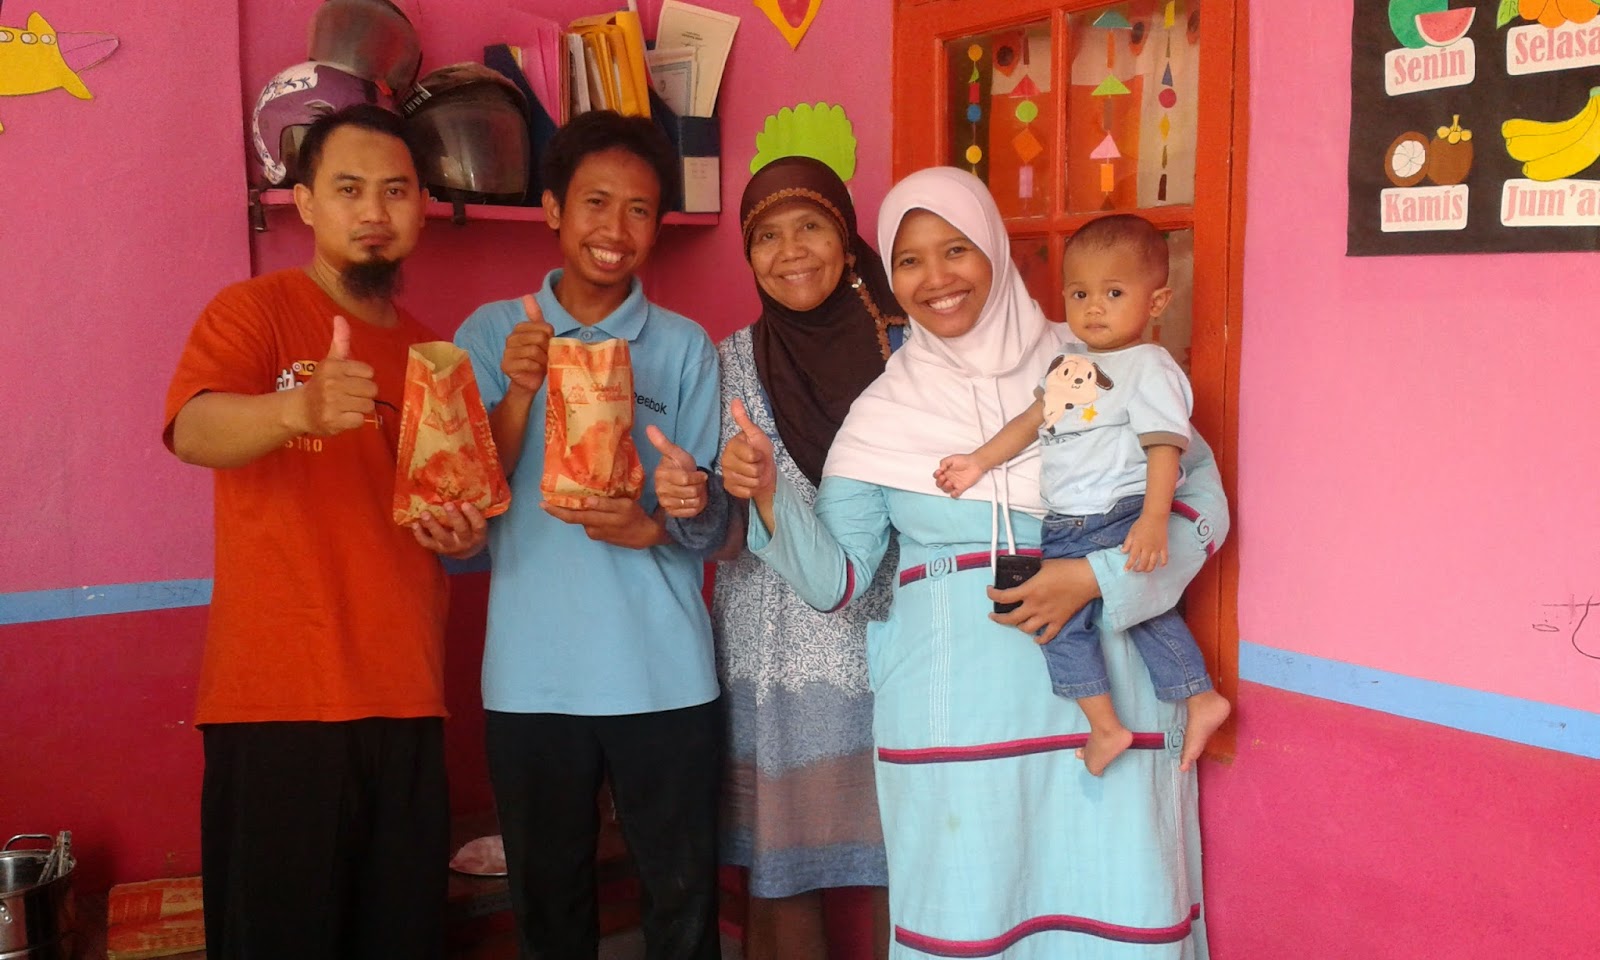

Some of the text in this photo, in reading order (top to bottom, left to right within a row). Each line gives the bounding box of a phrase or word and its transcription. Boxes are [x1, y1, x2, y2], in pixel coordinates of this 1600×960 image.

[1515, 26, 1600, 65] Selasa
[1394, 48, 1466, 86] Senin
[1384, 189, 1463, 223] Kamis
[1503, 184, 1600, 222] Jum'a
